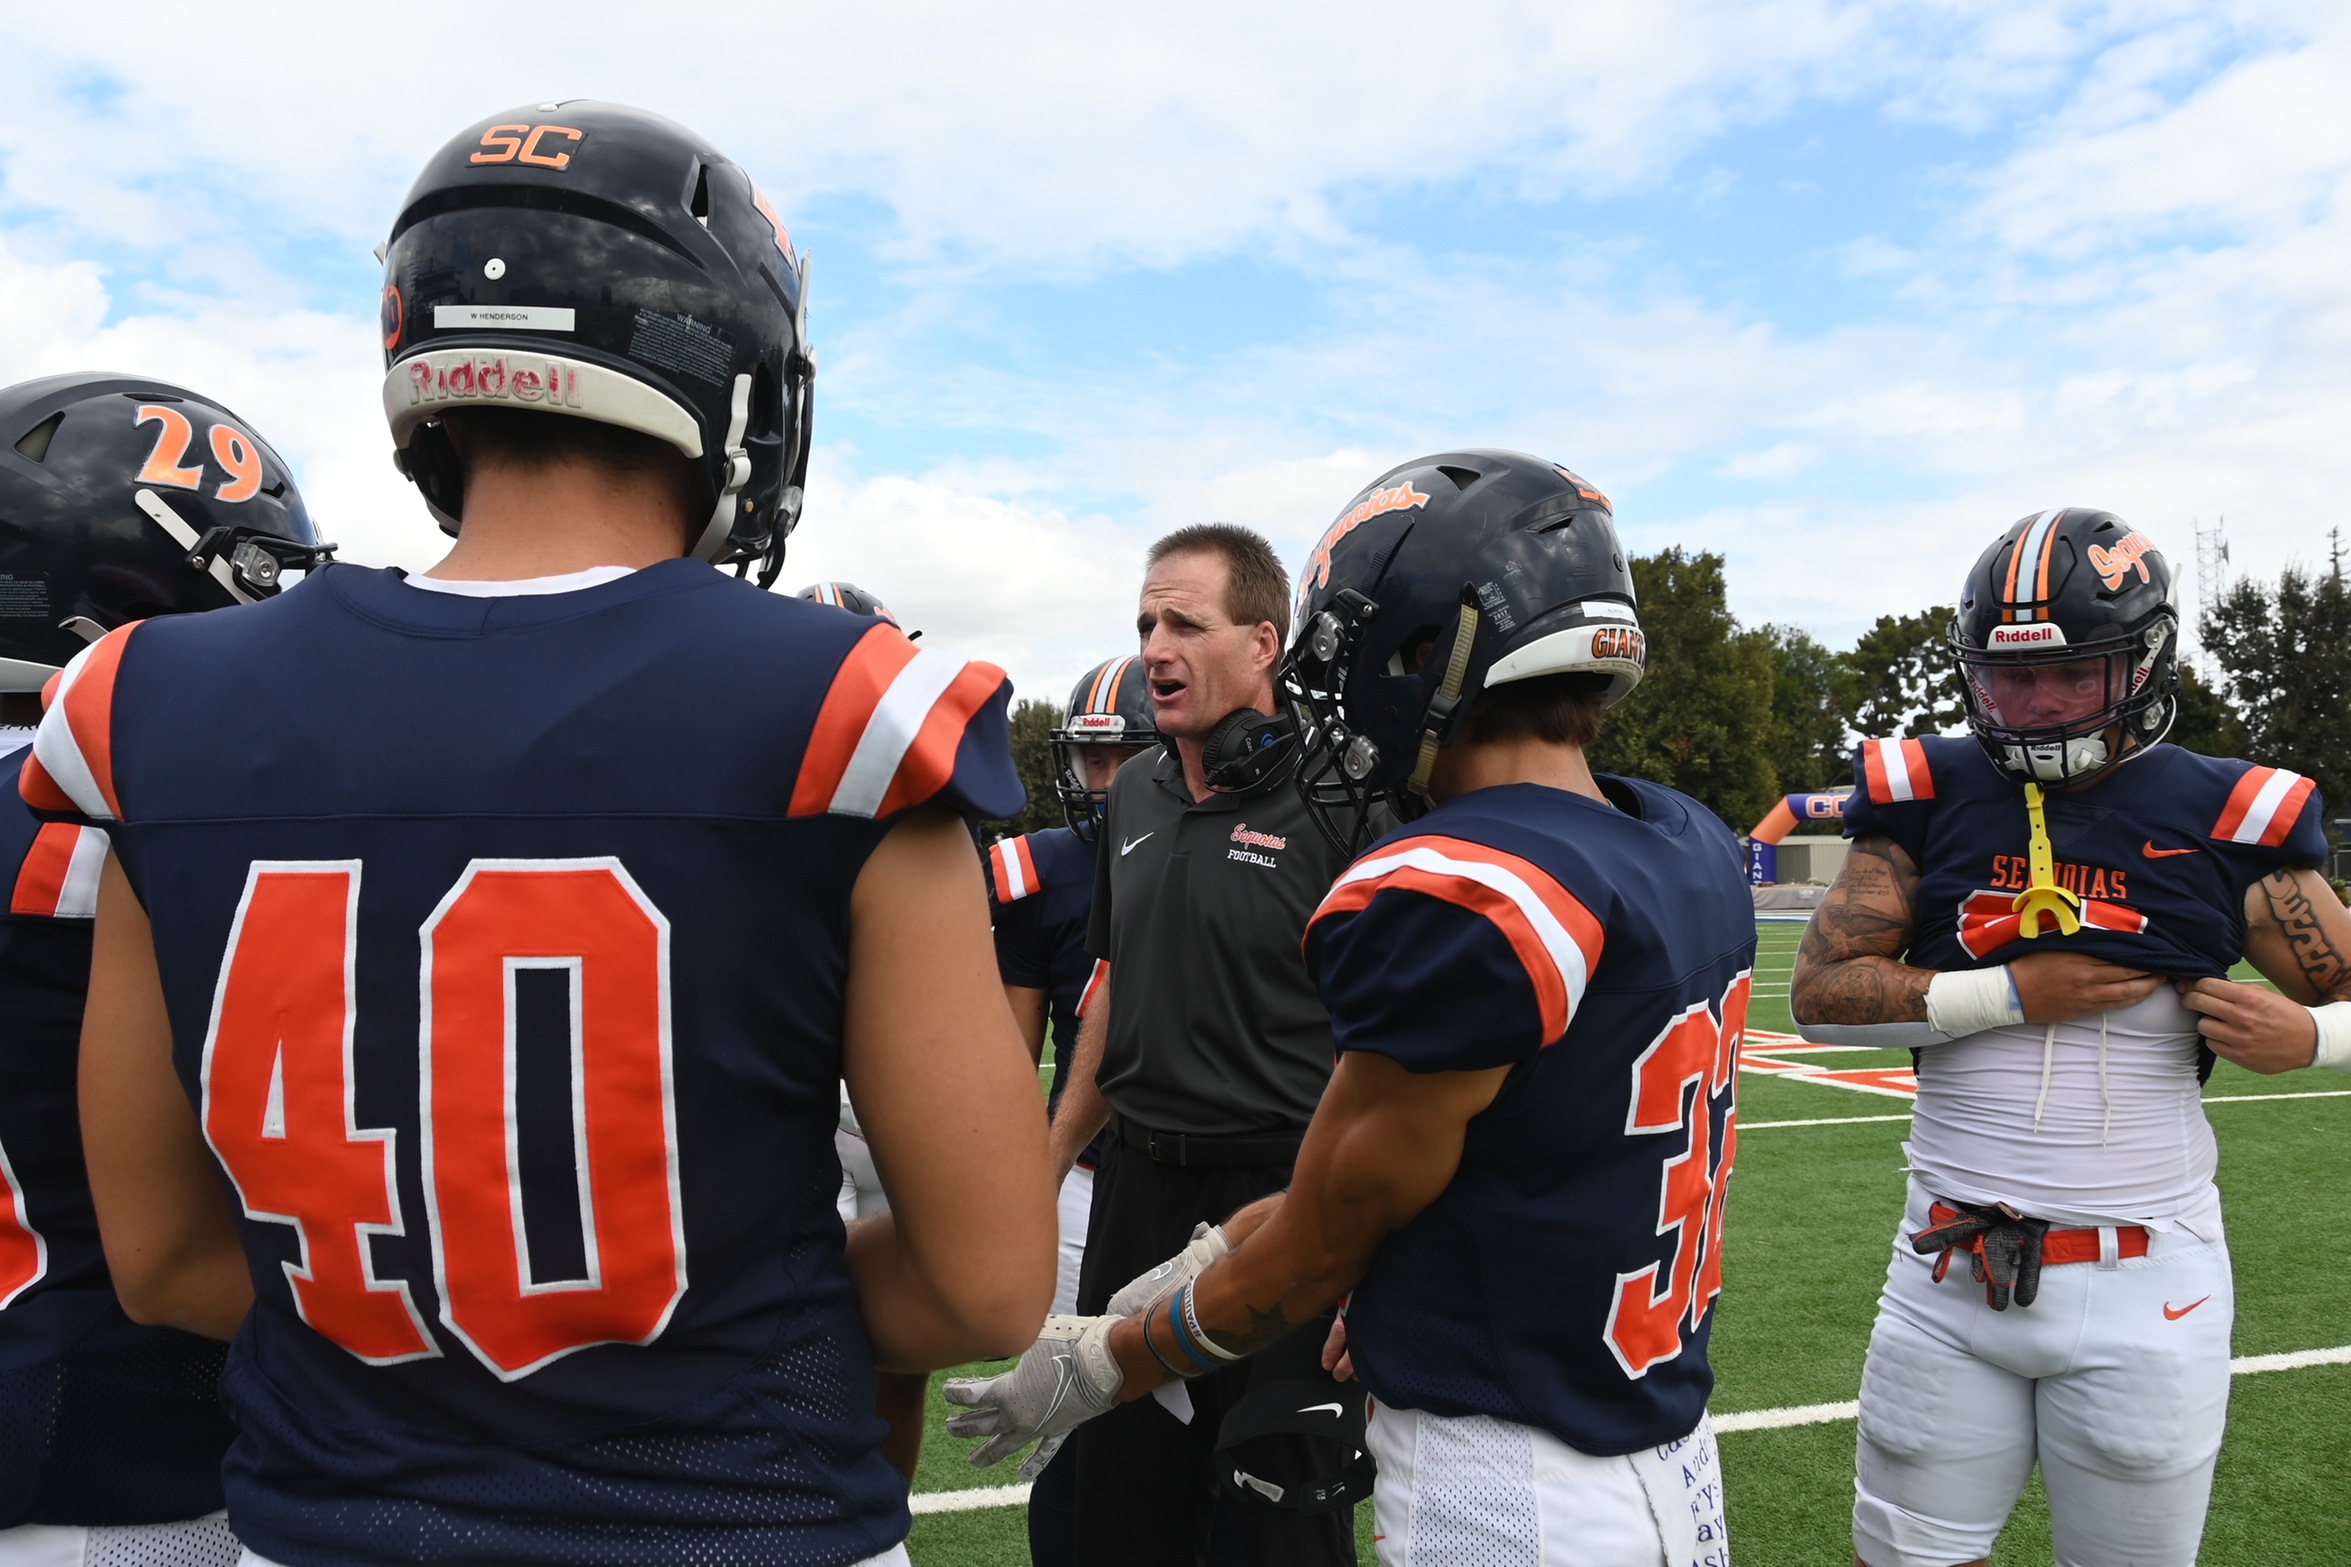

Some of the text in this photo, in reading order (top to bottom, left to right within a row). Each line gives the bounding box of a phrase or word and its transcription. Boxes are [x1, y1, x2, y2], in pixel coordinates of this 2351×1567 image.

[470, 124, 584, 168] SC
[480, 313, 528, 321] HENDERSON
[408, 354, 583, 408] Riddell
[132, 404, 263, 503] 29
[1995, 628, 2053, 643] Riddell
[1082, 717, 1110, 727] Riddell
[1230, 822, 1287, 850] Sequoias
[1227, 849, 1276, 868] FOOTBALL
[200, 856, 688, 1382] 40
